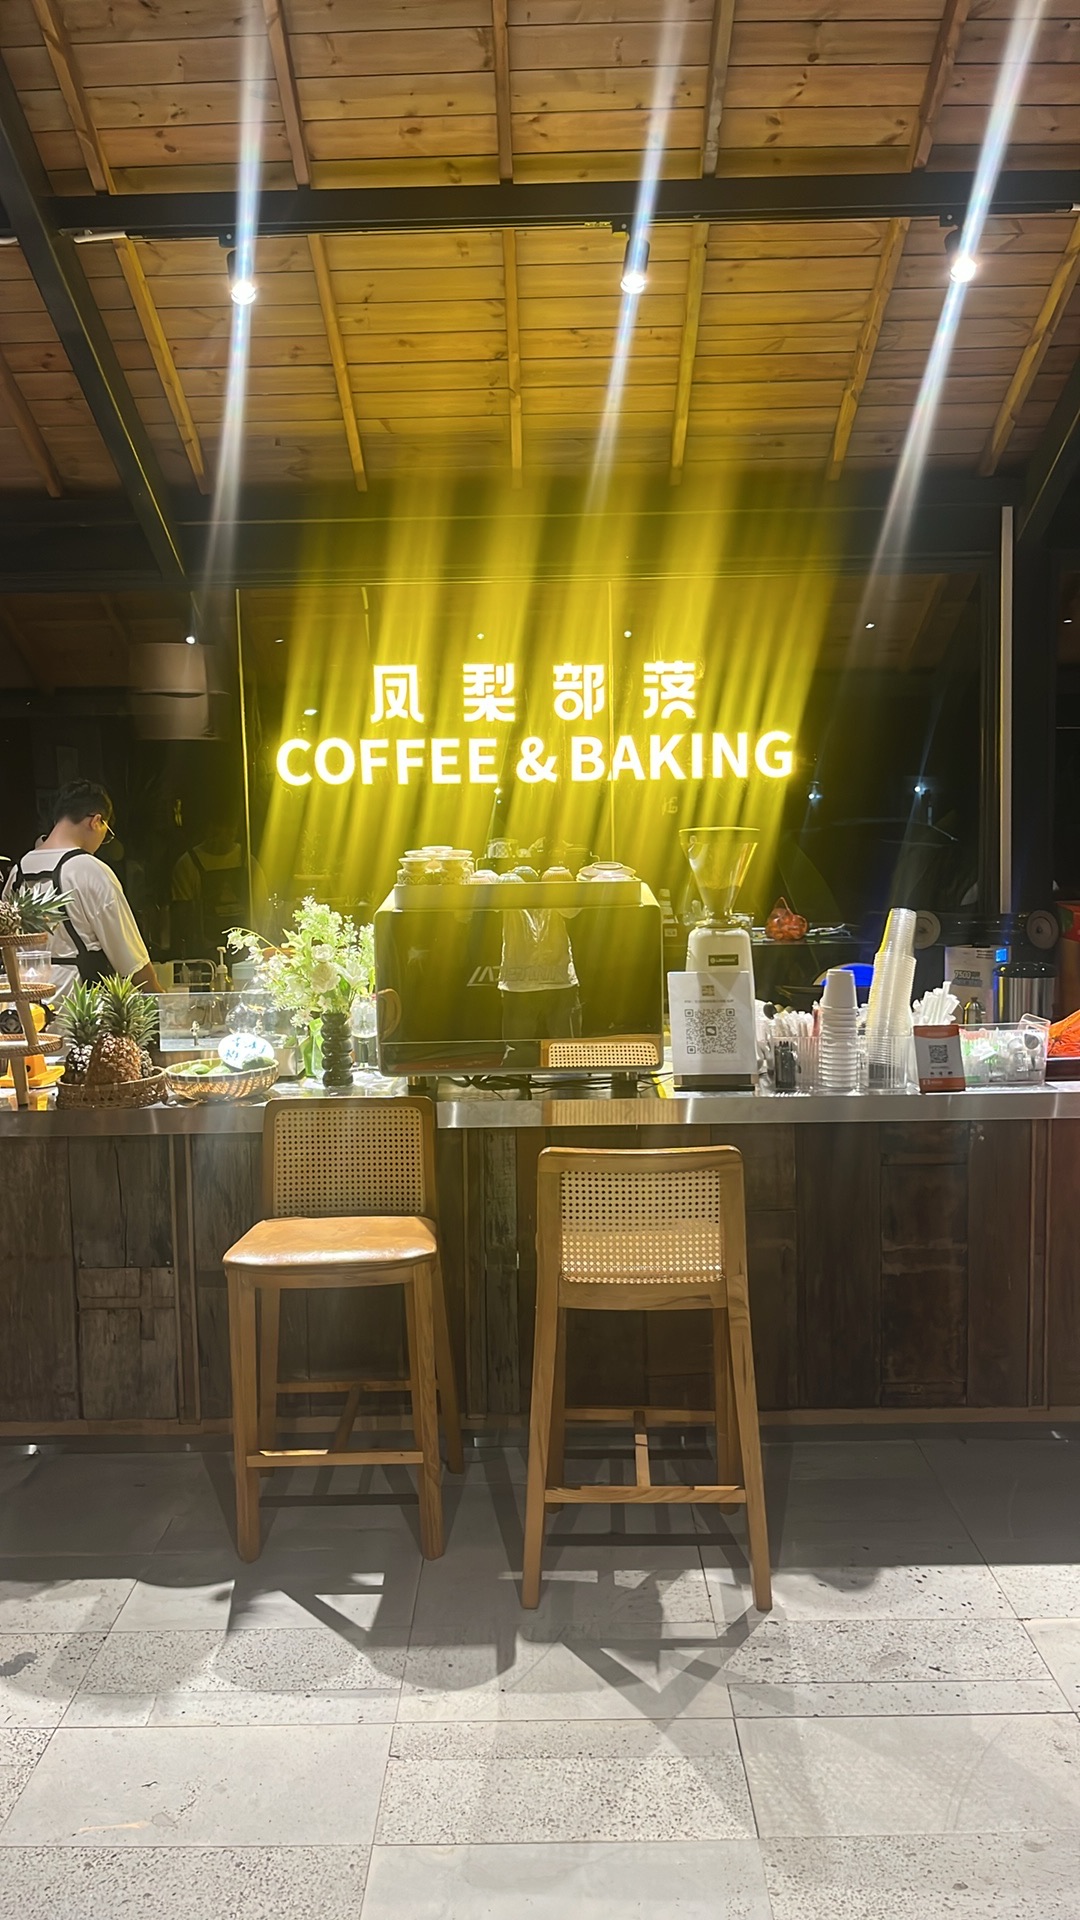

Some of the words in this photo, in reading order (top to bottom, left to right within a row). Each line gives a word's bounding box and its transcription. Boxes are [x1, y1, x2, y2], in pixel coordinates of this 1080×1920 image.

[370, 660, 697, 724] 凤梨部落
[276, 737, 499, 786] COFFEE
[515, 736, 558, 784] &
[570, 730, 794, 782] BAKING
